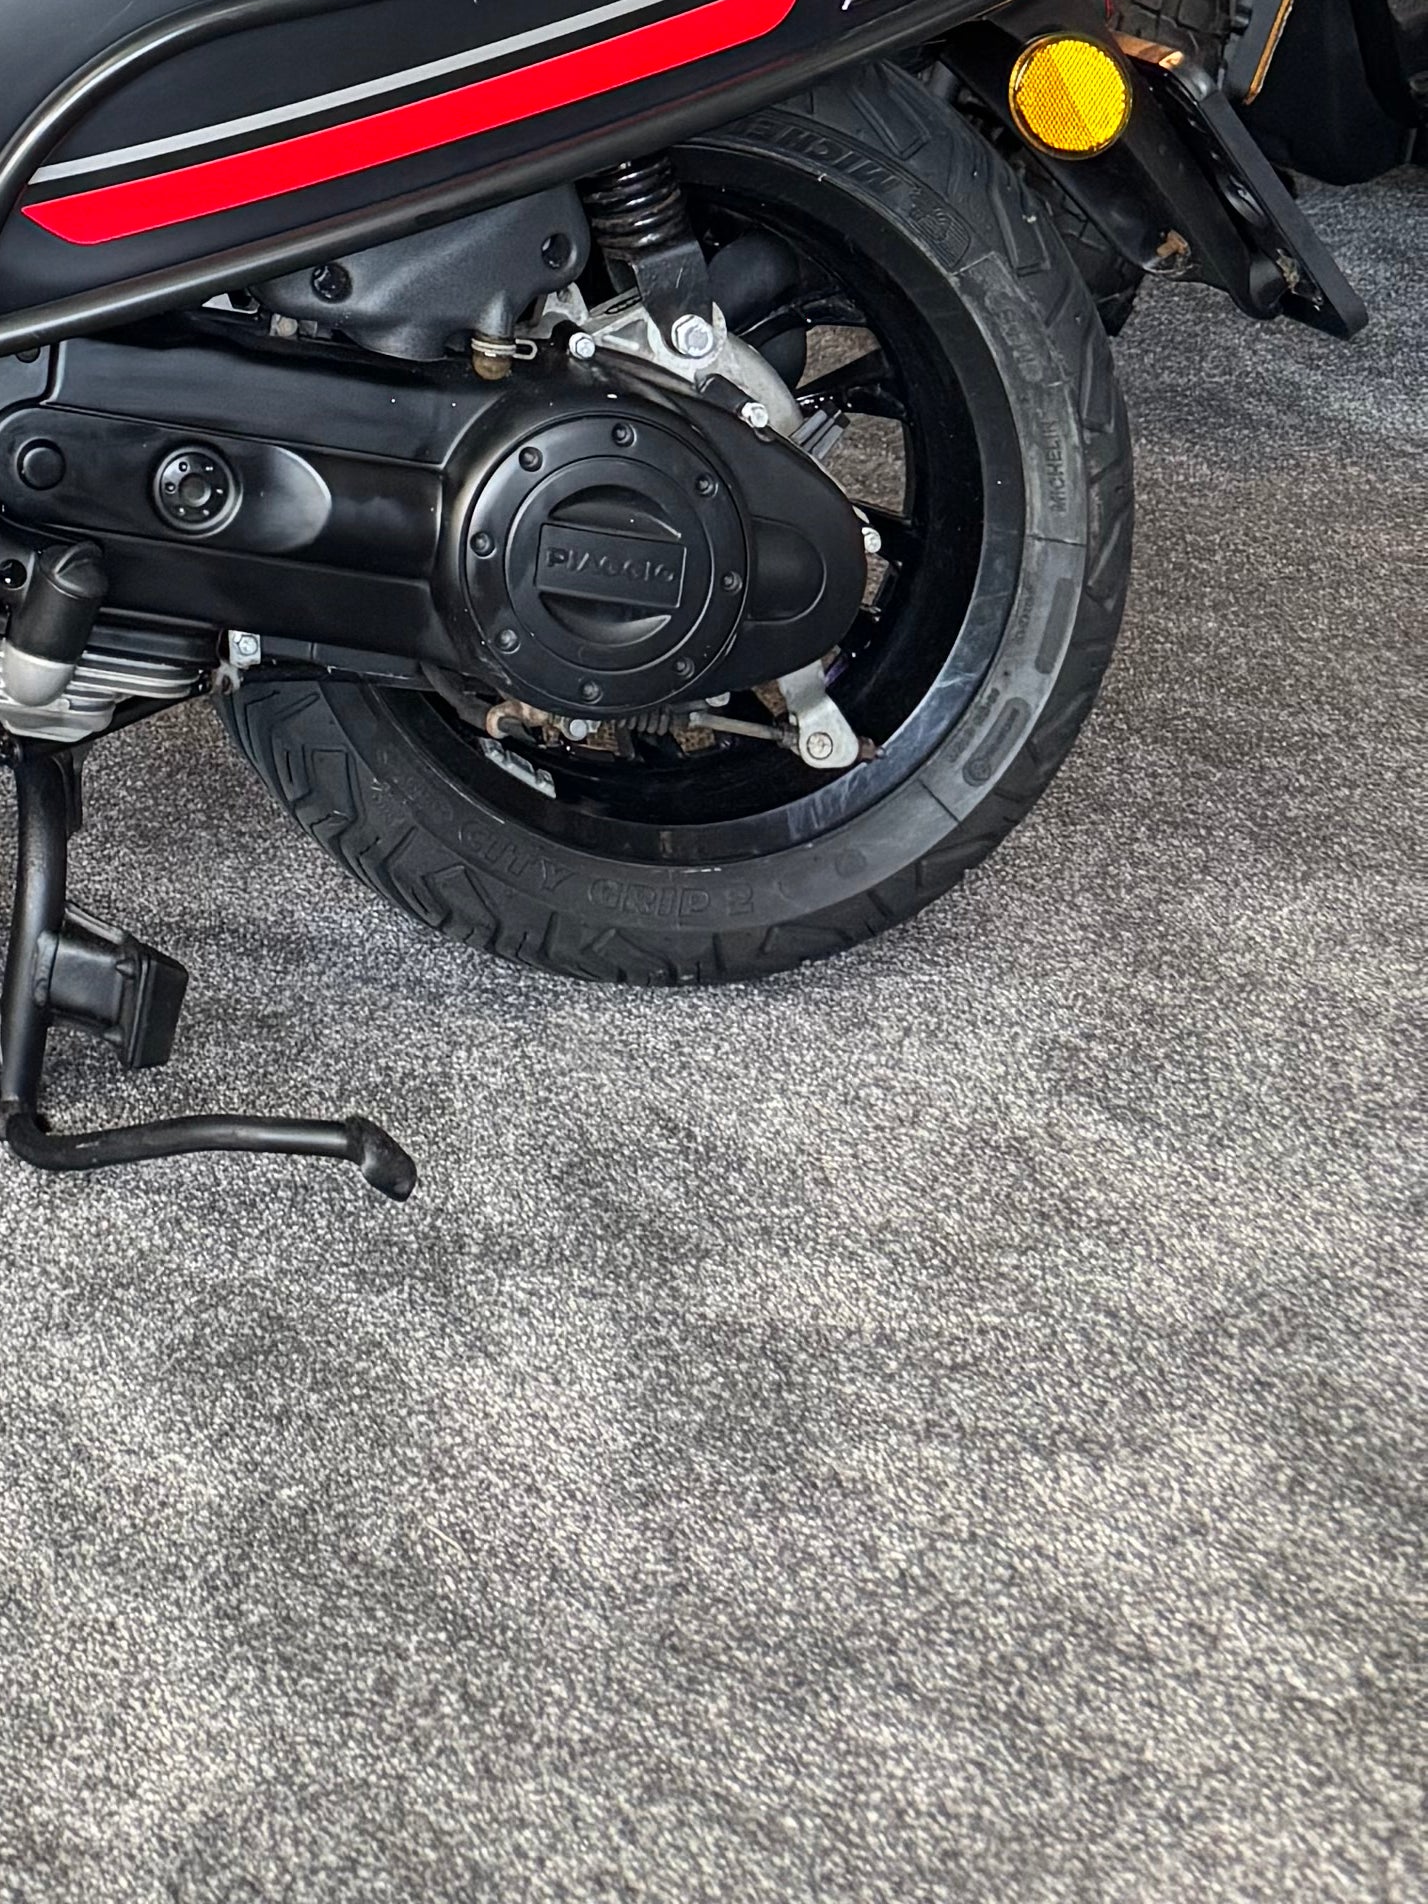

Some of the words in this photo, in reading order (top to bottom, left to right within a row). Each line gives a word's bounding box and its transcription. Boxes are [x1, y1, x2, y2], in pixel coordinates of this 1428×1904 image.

[1050, 418, 1068, 515] MICHELIN
[545, 545, 676, 585] PIAGGIO
[458, 822, 577, 892] CITY
[588, 878, 711, 920] GRIP
